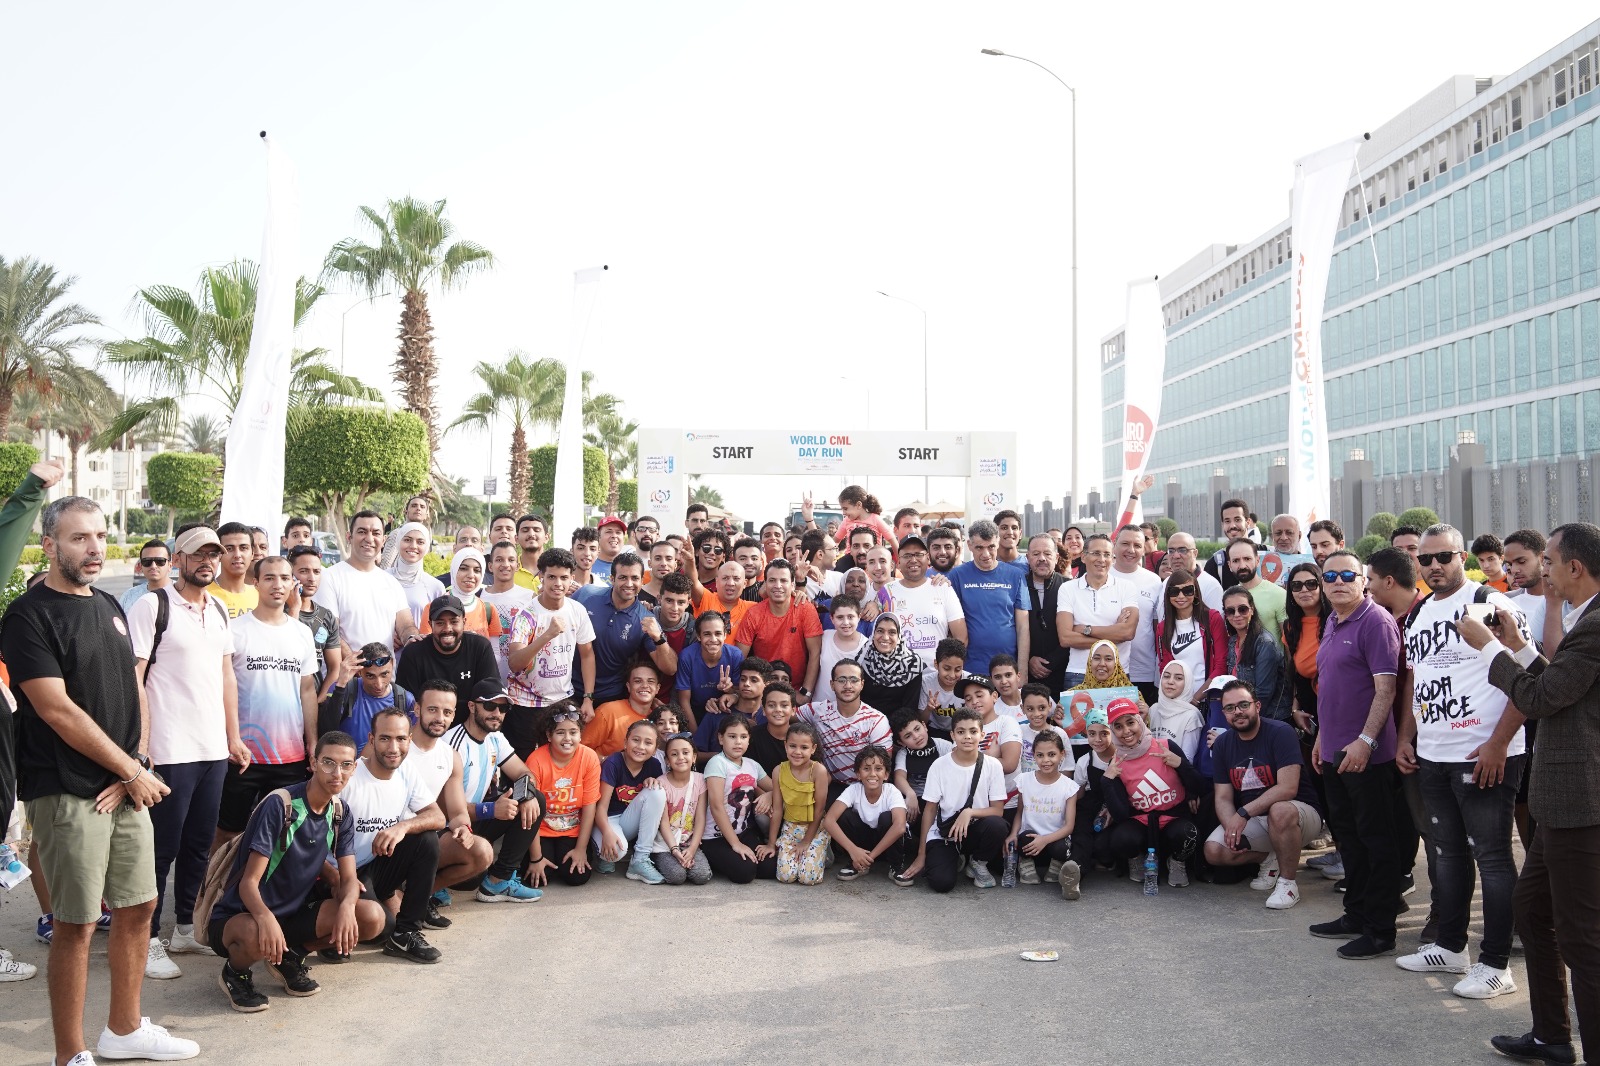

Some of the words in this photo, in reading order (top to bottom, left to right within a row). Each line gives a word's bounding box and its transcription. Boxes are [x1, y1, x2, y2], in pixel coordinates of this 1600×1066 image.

[790, 435, 827, 445] WORLD
[829, 435, 852, 446] CML
[713, 446, 754, 459] START
[798, 447, 819, 457] DAY
[822, 447, 843, 458] RUN
[898, 447, 940, 460] START
[915, 614, 939, 625] saib
[1175, 630, 1197, 646] NIKE
[552, 643, 572, 654] saib
[246, 663, 269, 671] CAIRO
[547, 788, 578, 803] VOL
[1132, 789, 1177, 809] adidas
